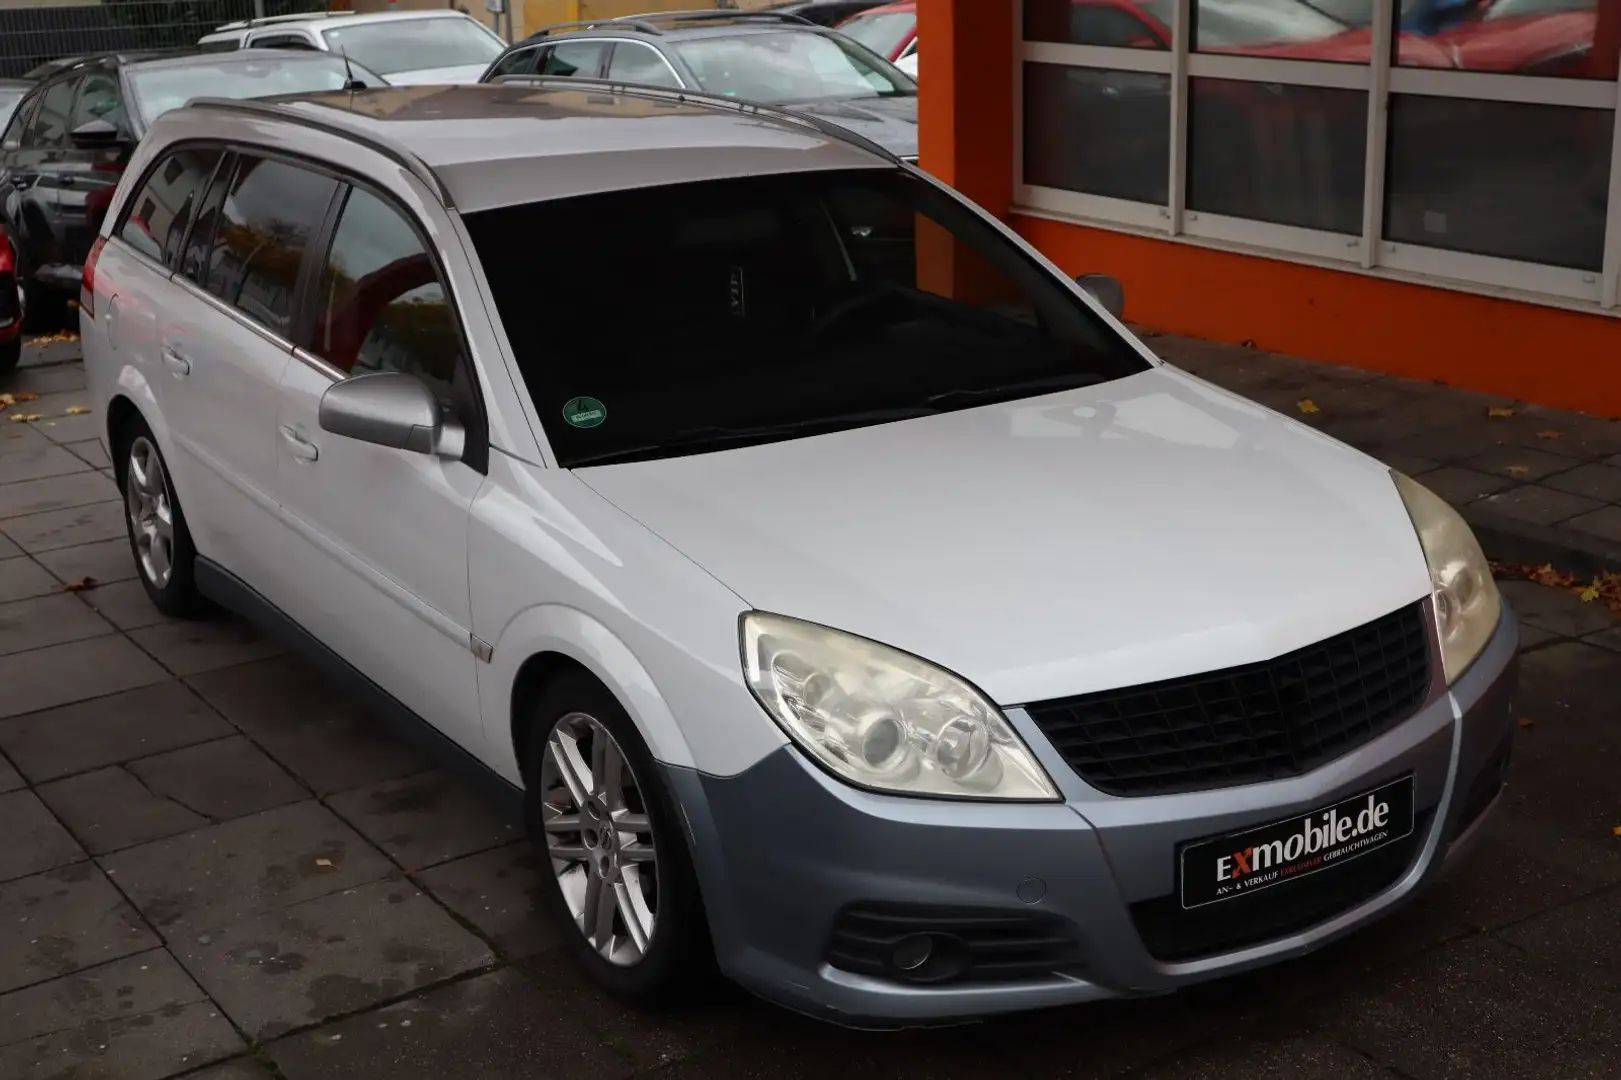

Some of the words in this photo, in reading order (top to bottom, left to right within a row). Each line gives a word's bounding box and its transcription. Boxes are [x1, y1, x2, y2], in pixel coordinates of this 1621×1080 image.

[1236, 882, 1242, 890] &
[1244, 870, 1279, 887] VERKAUF
[1323, 831, 1388, 861] GEBRAUCHTWAGEN
